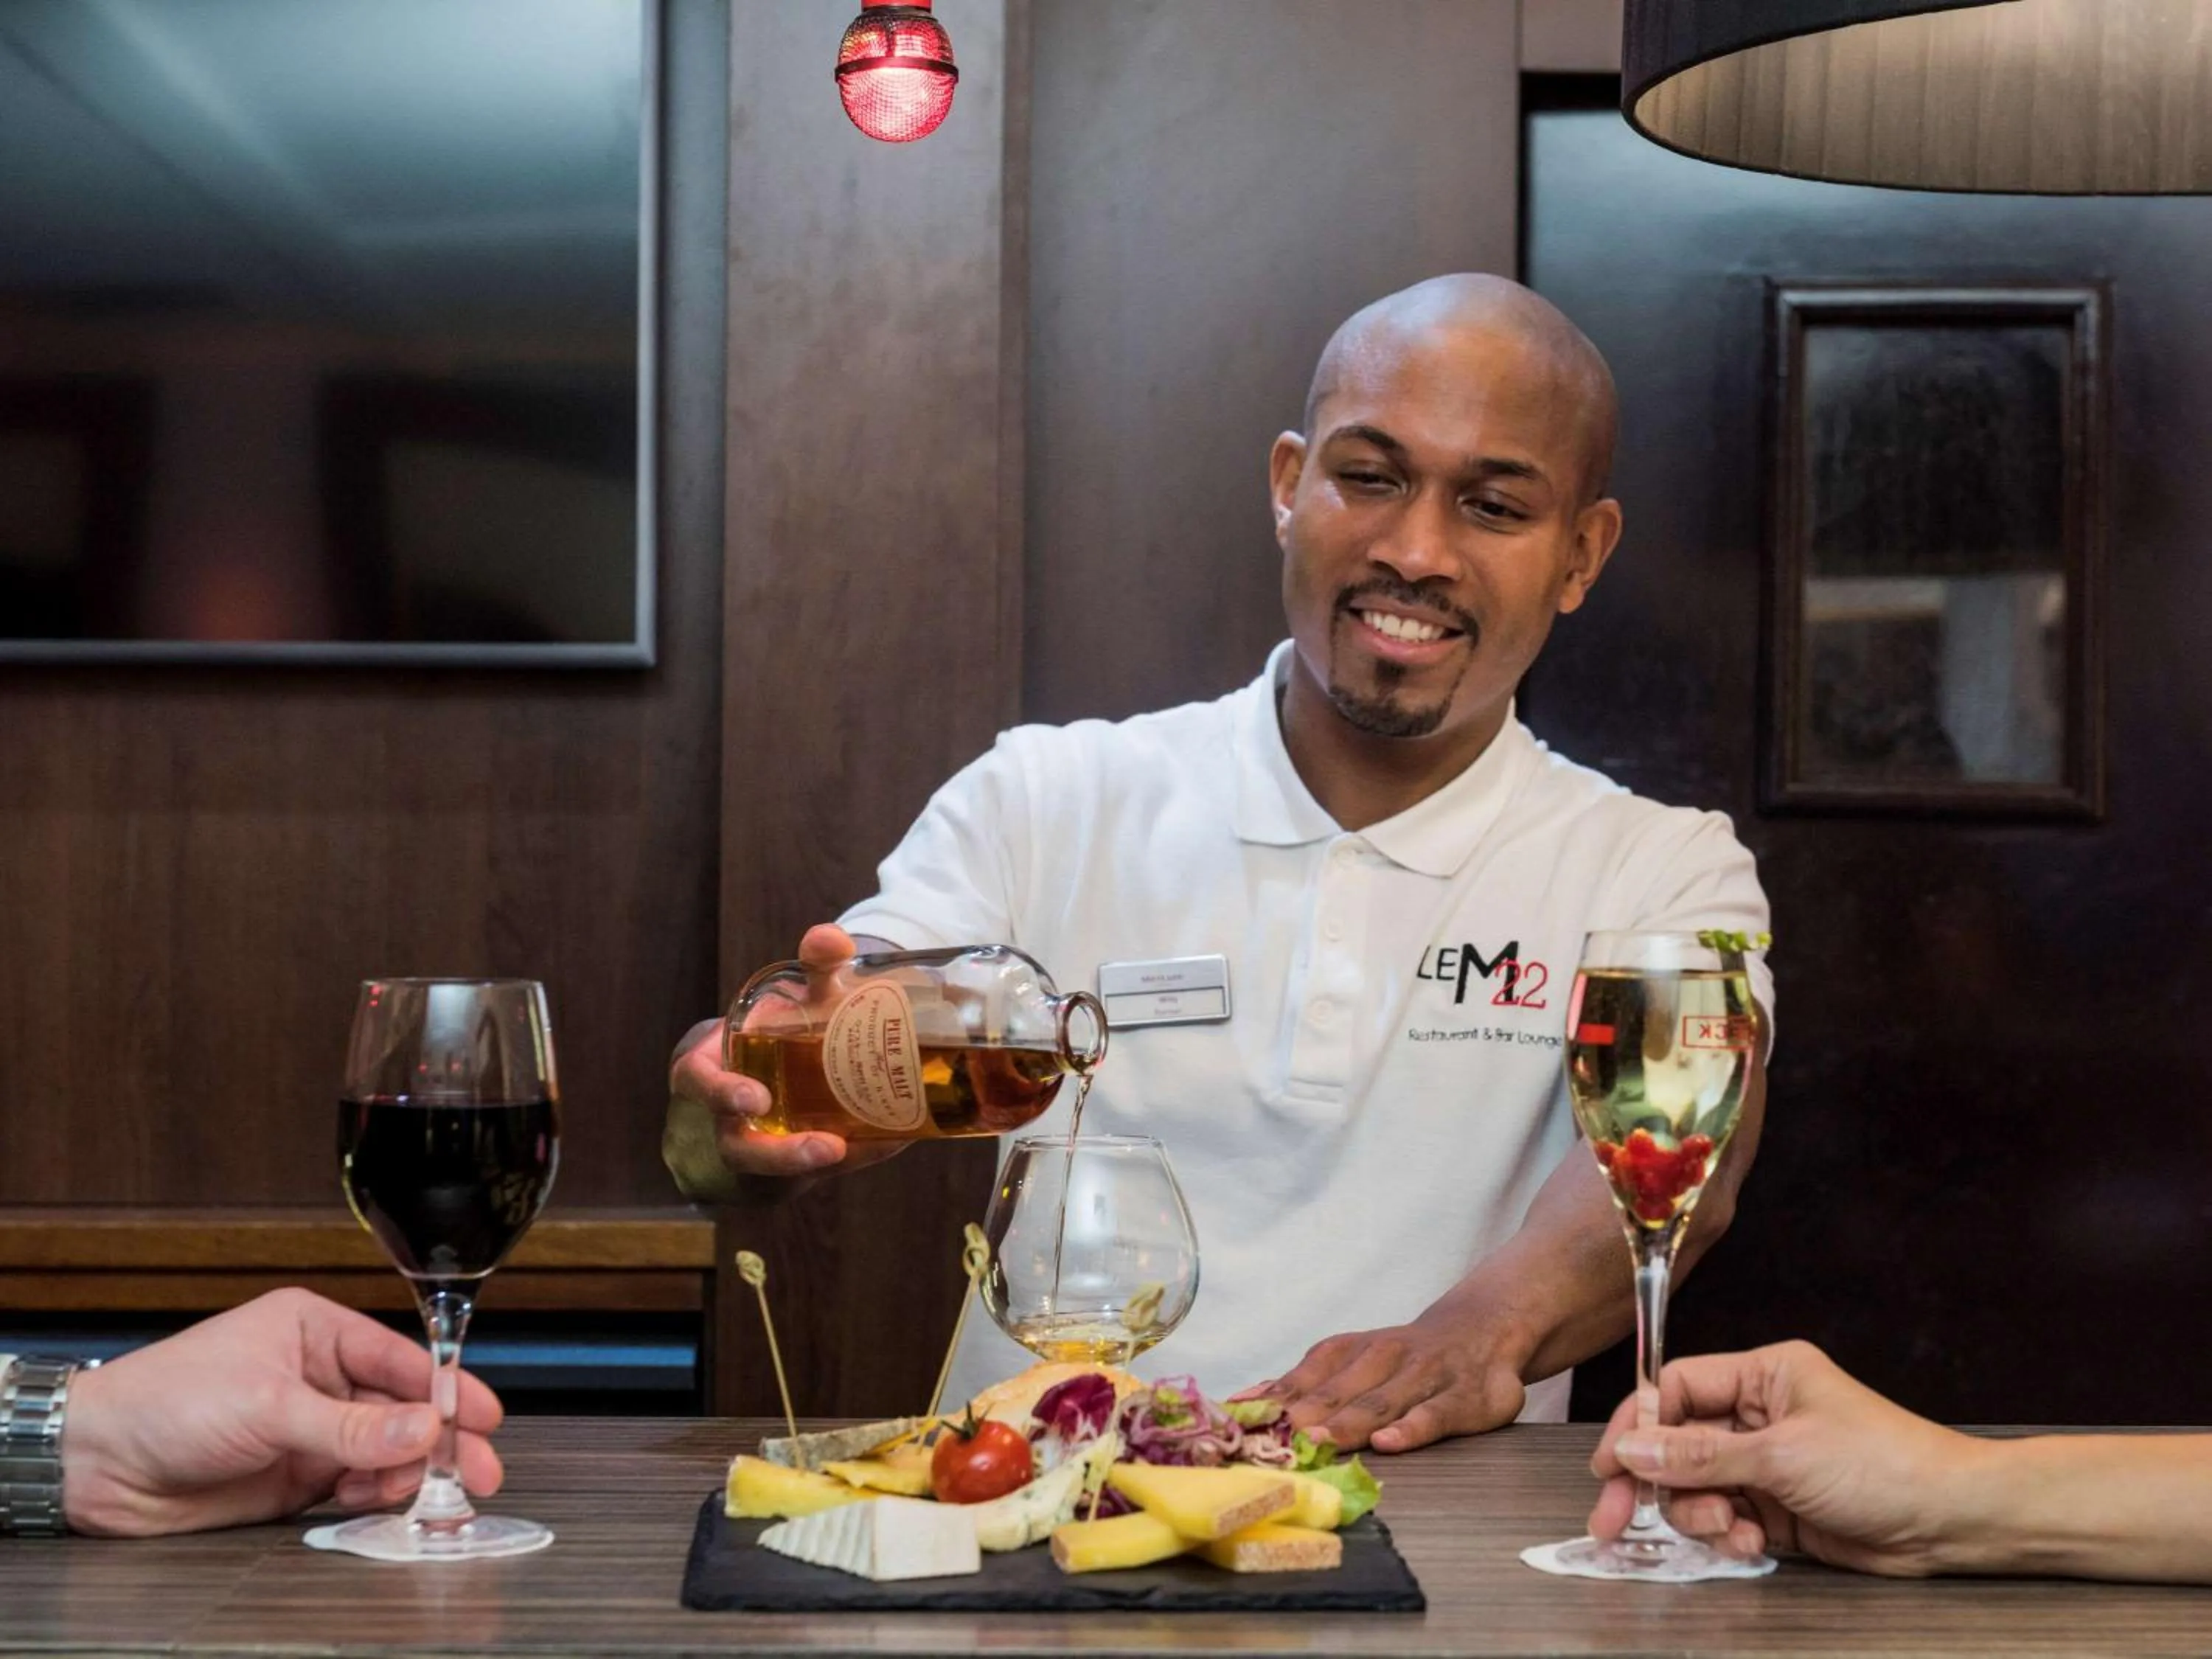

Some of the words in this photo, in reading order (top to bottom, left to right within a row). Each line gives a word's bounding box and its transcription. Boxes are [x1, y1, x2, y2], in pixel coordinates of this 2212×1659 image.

[886, 1018, 902, 1056] PURE
[1408, 1028, 1478, 1042] Restaurant
[1483, 1027, 1492, 1041] &
[1495, 1027, 1514, 1042] Bar
[1518, 1031, 1562, 1049] Lounge
[891, 1066, 913, 1099] MALT
